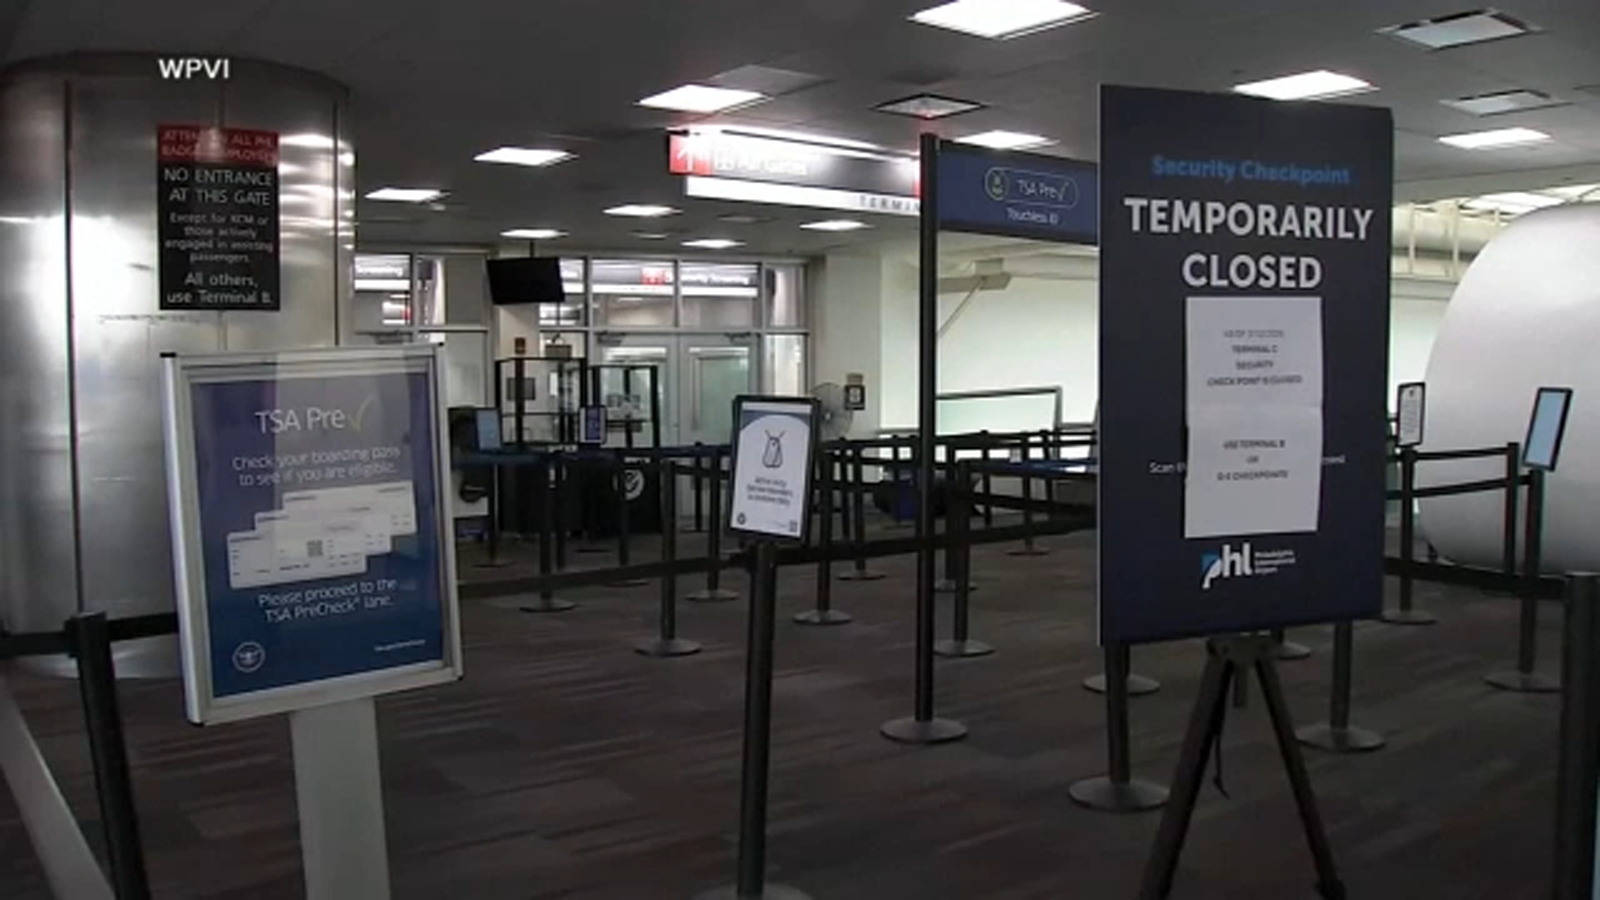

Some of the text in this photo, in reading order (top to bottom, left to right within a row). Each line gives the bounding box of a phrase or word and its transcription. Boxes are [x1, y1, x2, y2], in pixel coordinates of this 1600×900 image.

[164, 168, 272, 187] NO ENTRANCE
[1153, 156, 1350, 186] Security Checkpoint
[169, 187, 271, 206] AT THIS GATE
[1016, 179, 1037, 196] TSA
[169, 212, 208, 224] Except
[210, 213, 227, 223] for
[257, 217, 269, 226] or
[1123, 197, 1374, 240] TEMPORARILY
[184, 226, 256, 240] those actively
[165, 239, 213, 251] engaged
[217, 240, 228, 249] in
[1182, 252, 1322, 288] CLOSED
[184, 272, 259, 288] All others,
[167, 292, 193, 303] use
[197, 289, 258, 304] Terminal
[254, 405, 347, 435] TSA Pre
[231, 446, 400, 471] Check your boarding pass
[1149, 462, 1174, 474] Scan
[239, 473, 254, 486] to
[256, 471, 280, 486] see
[296, 468, 322, 484] you
[324, 466, 347, 480] are
[258, 578, 398, 607] Please proceed to the
[264, 606, 293, 624] TSA
